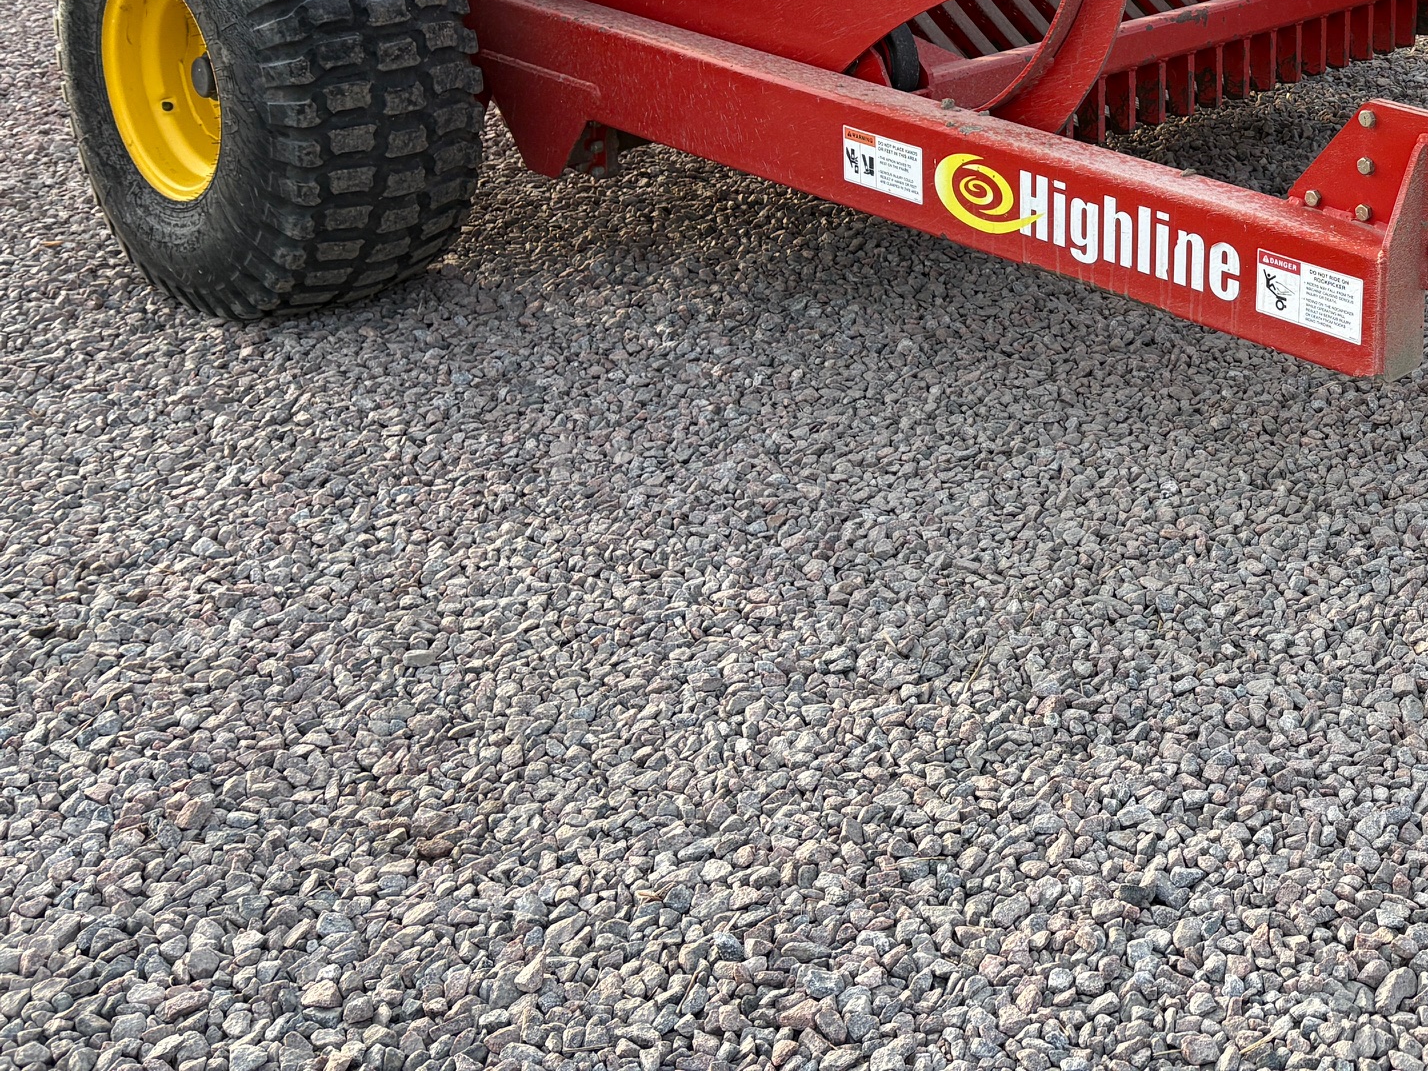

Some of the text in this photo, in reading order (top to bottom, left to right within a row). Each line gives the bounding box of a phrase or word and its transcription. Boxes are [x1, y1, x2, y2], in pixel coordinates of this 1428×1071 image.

[853, 133, 873, 144] WARNING
[1019, 169, 1240, 301] Highline
[1270, 257, 1297, 271] DANGER
[1314, 276, 1346, 291] ROCKPICKER
[1329, 275, 1340, 283] RIDE
